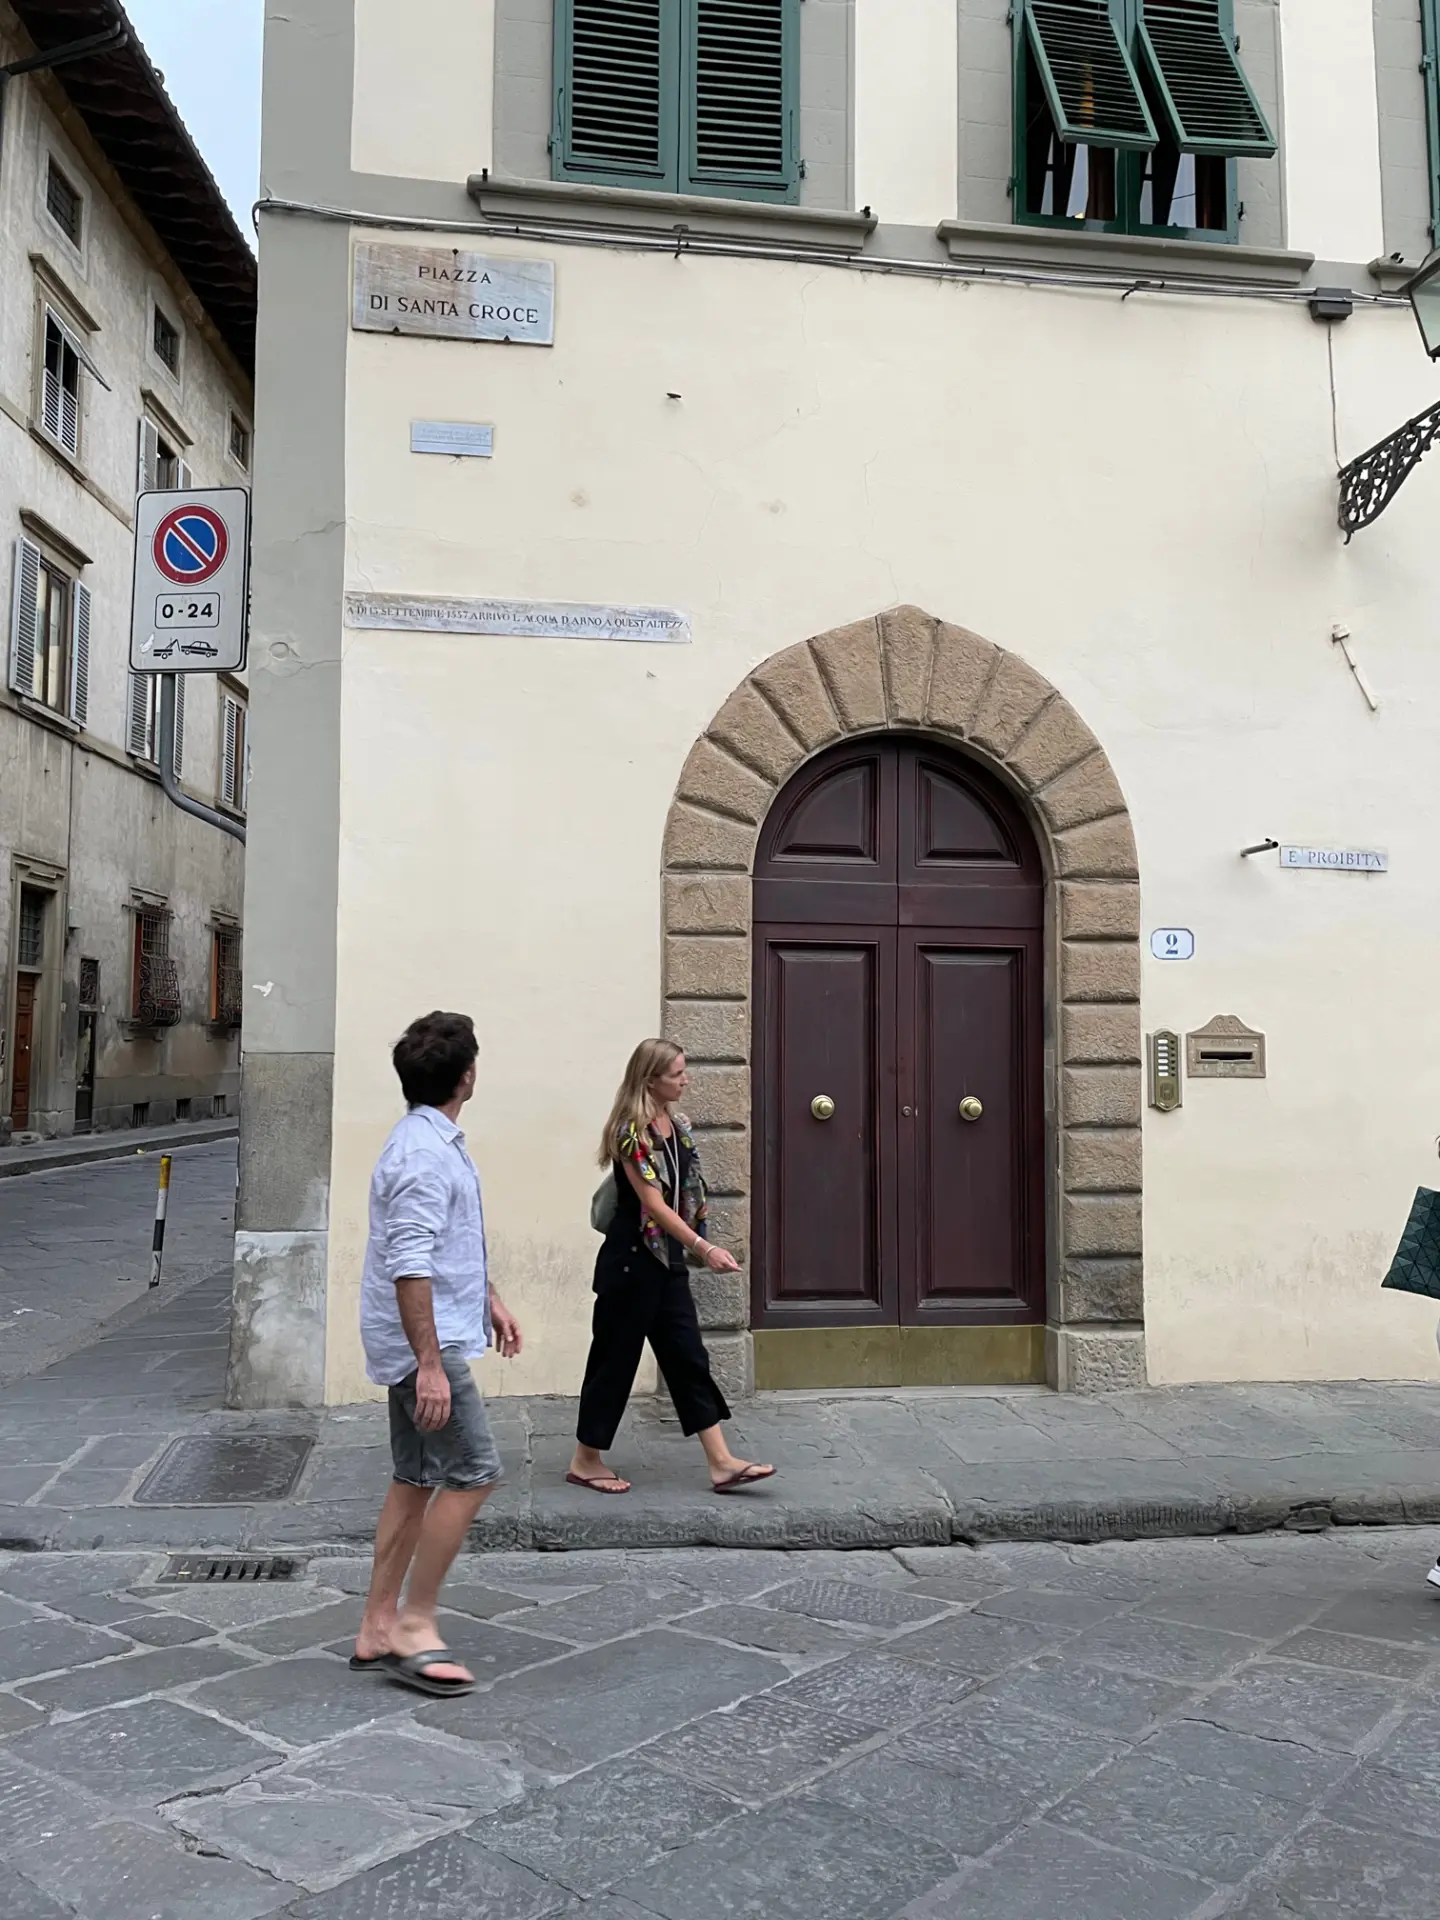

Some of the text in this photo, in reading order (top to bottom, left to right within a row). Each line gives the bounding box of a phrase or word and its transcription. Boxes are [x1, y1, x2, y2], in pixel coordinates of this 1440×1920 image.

[418, 265, 492, 285] PIAZZA
[370, 294, 539, 324] DI SANTA CROCE
[381, 607, 445, 618] SETTEMBRE
[523, 614, 558, 625] ACQUA
[571, 616, 602, 626] ARNO
[1308, 851, 1382, 867] PROIBITA
[1165, 933, 1179, 955] 2
